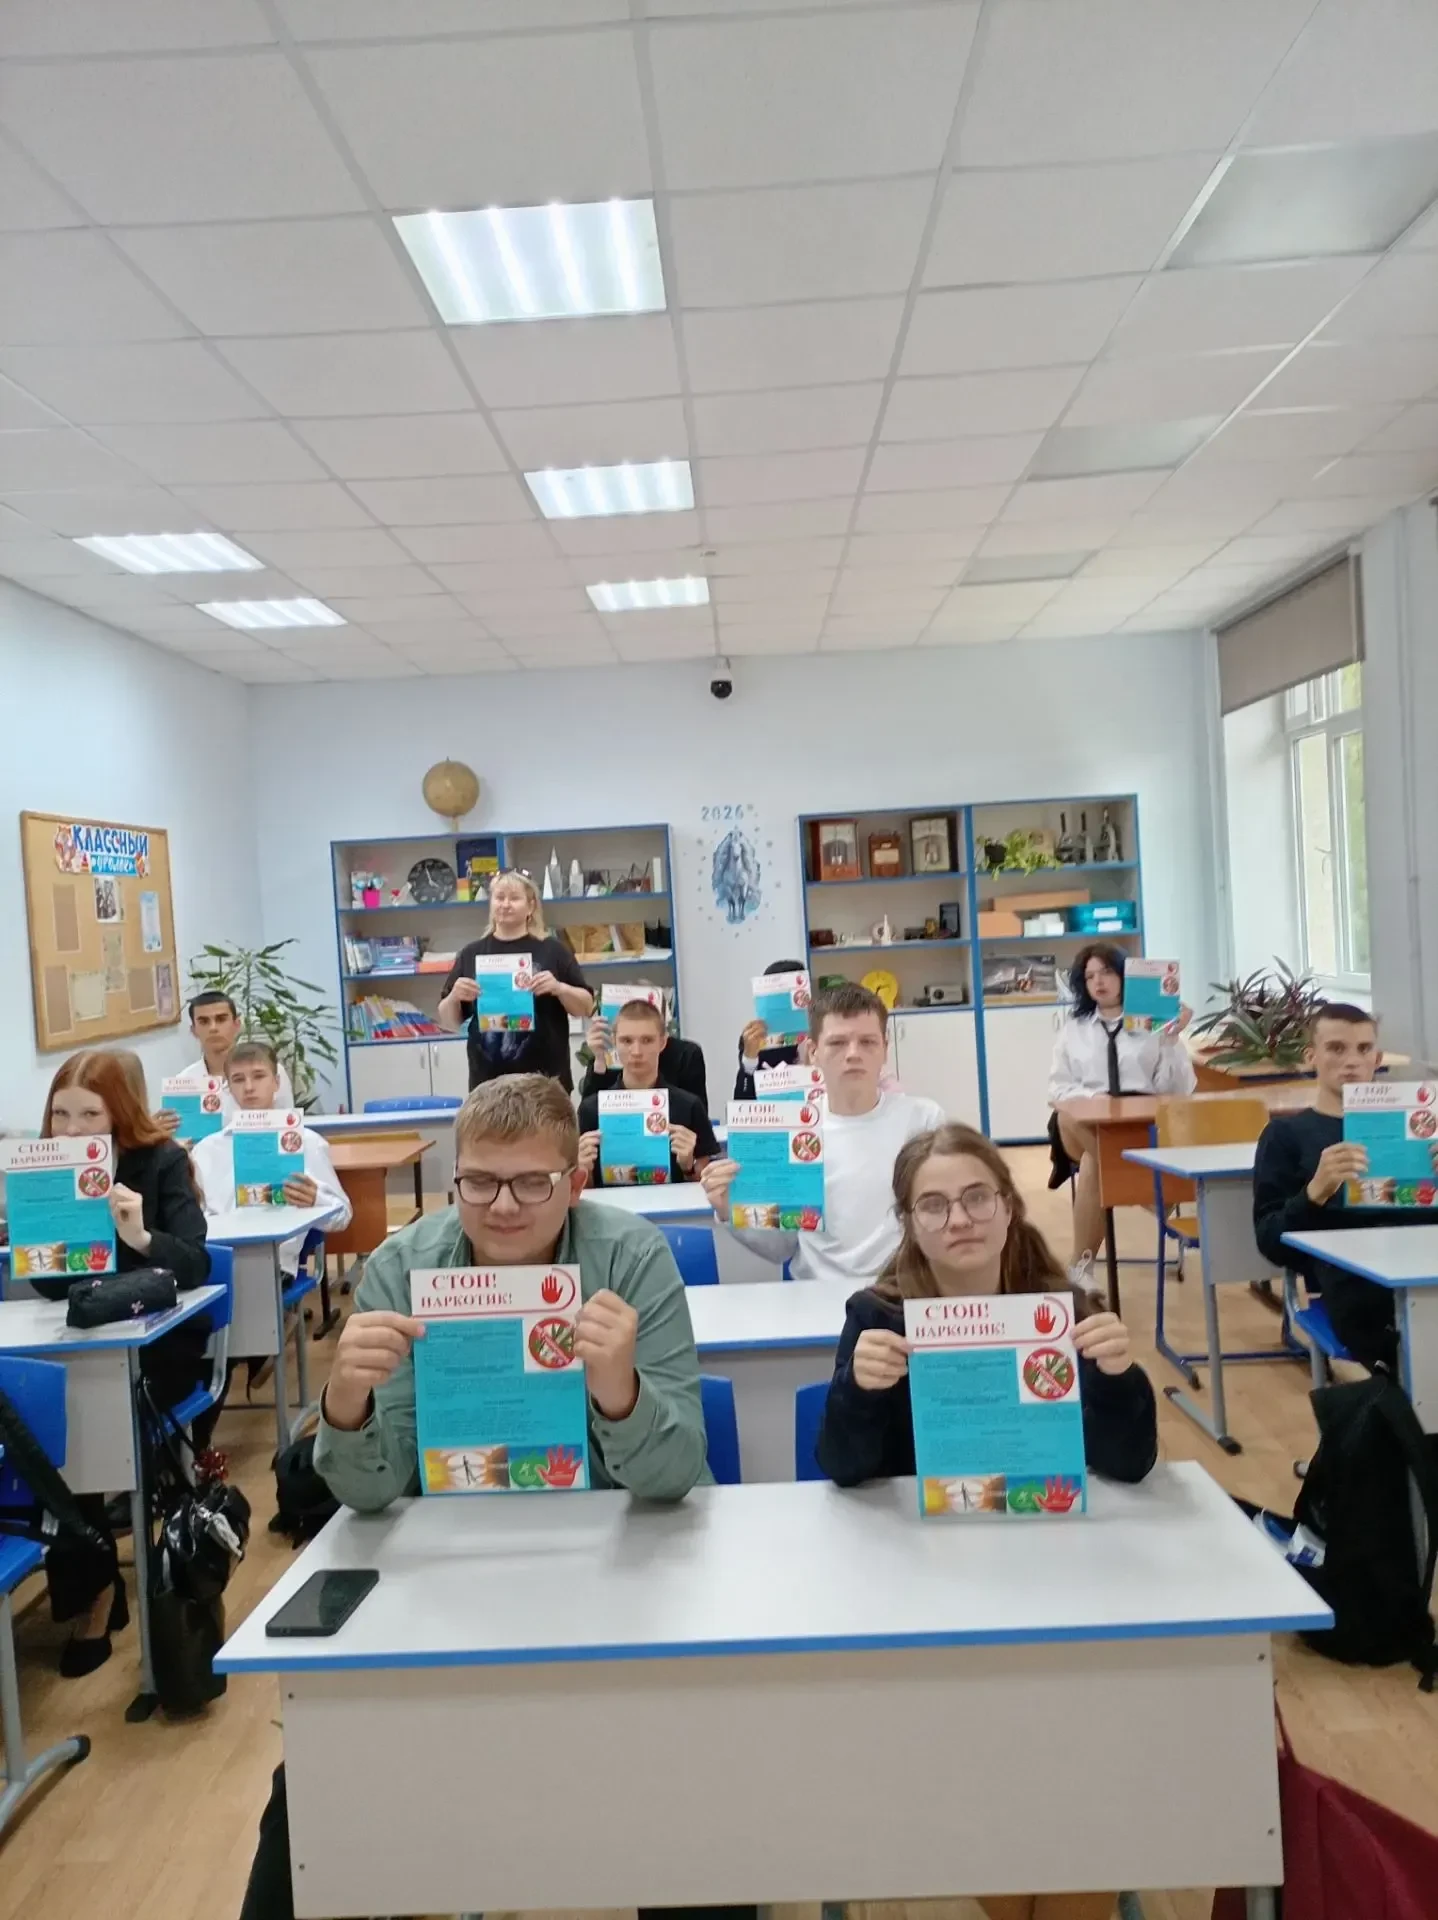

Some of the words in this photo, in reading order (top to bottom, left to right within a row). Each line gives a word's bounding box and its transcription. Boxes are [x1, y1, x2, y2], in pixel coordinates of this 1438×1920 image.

[700, 803, 744, 819] 2026
[73, 825, 148, 856] КЛАССНЫЙ
[18, 1141, 60, 1154] СТОП!
[432, 1272, 498, 1290] СТОП!
[421, 1293, 513, 1309] НАРКОТИК!
[925, 1302, 990, 1321] СТОП!
[915, 1321, 1006, 1339] НАРКОТИК!
